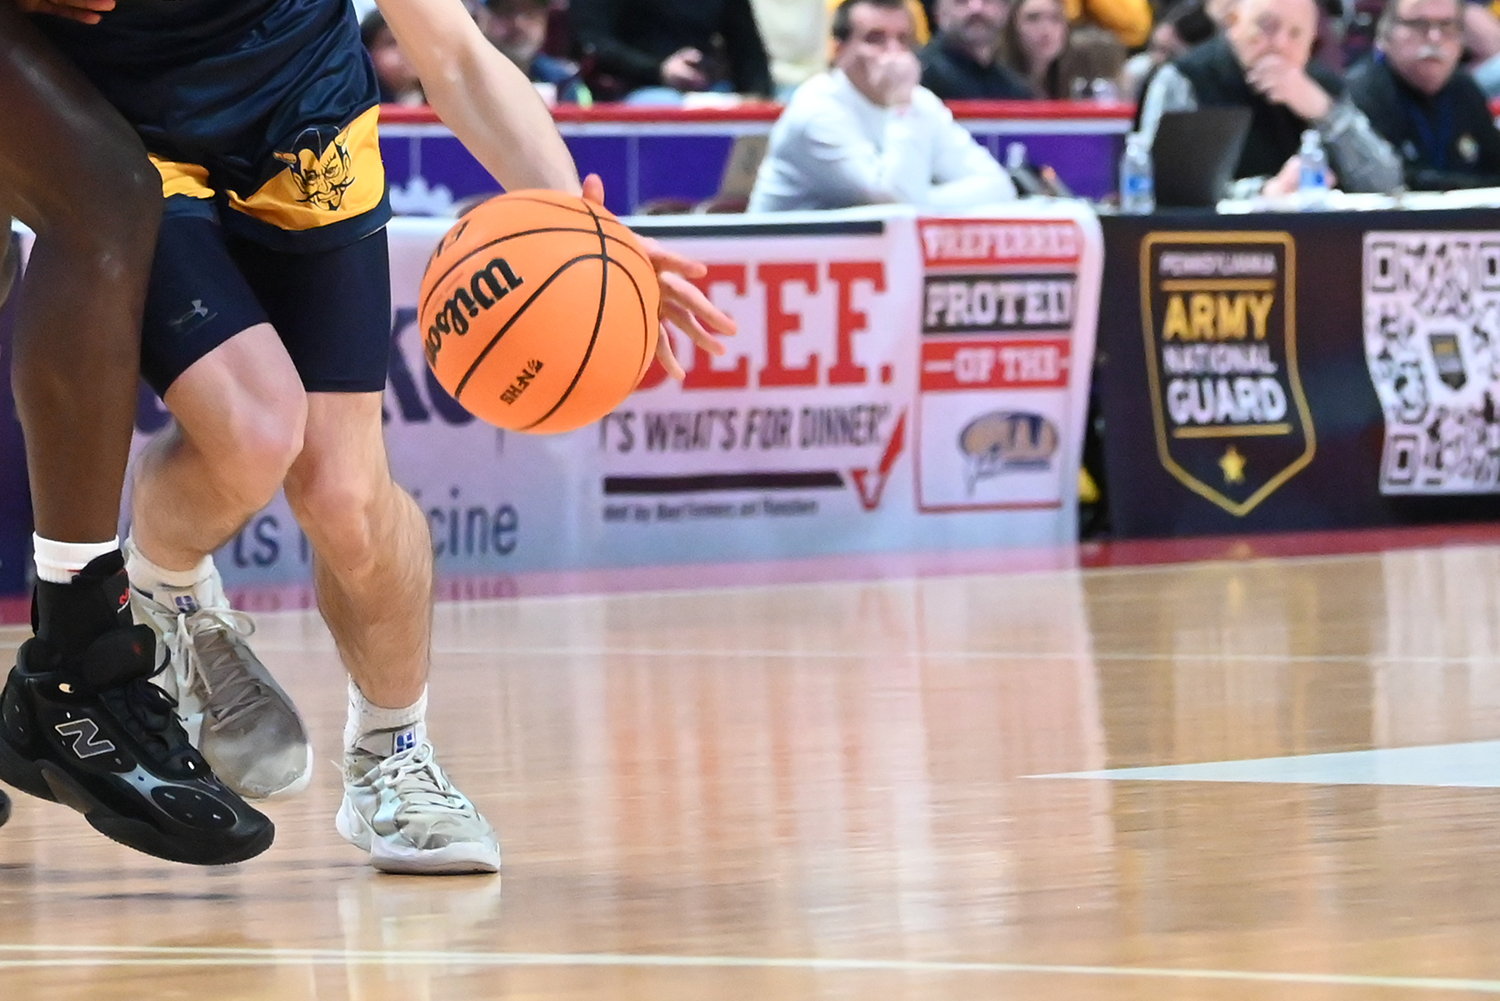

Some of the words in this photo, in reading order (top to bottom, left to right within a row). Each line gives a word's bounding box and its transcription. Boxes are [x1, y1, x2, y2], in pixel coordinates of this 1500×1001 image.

[637, 262, 894, 391] EEF.
[1162, 292, 1274, 341] ARMY
[1167, 377, 1287, 424] GUARD
[644, 407, 739, 452] WHAT'S
[742, 406, 795, 449] FOR
